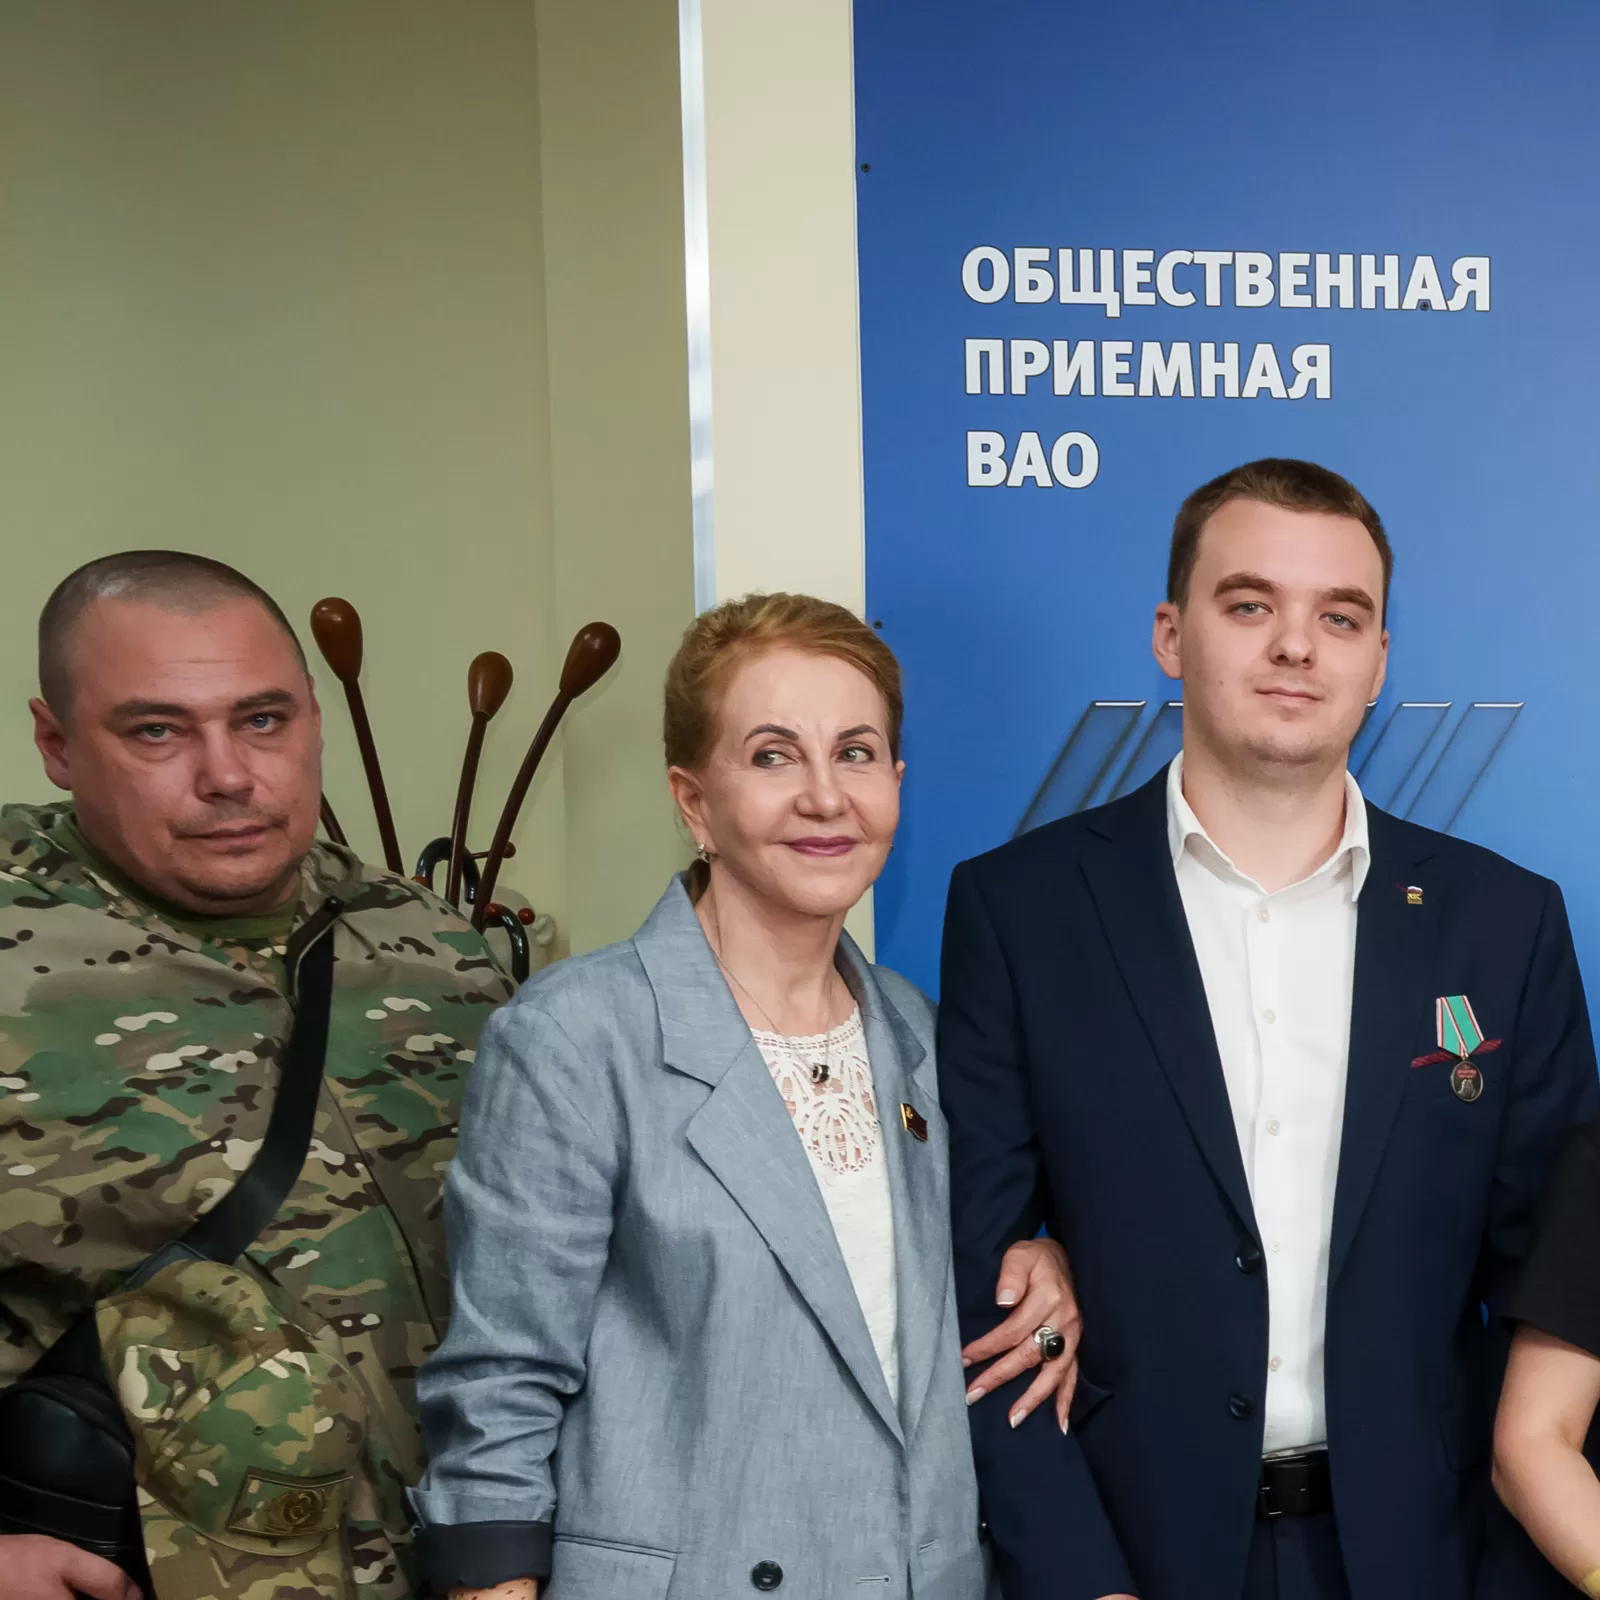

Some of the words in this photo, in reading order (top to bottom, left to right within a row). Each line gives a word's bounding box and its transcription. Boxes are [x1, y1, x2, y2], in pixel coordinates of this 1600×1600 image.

[961, 245, 1492, 318] ОБЩЕСТВЕННАЯ
[964, 338, 1332, 400] ПРИЕМНАЯ
[966, 430, 1100, 489] ВАО
